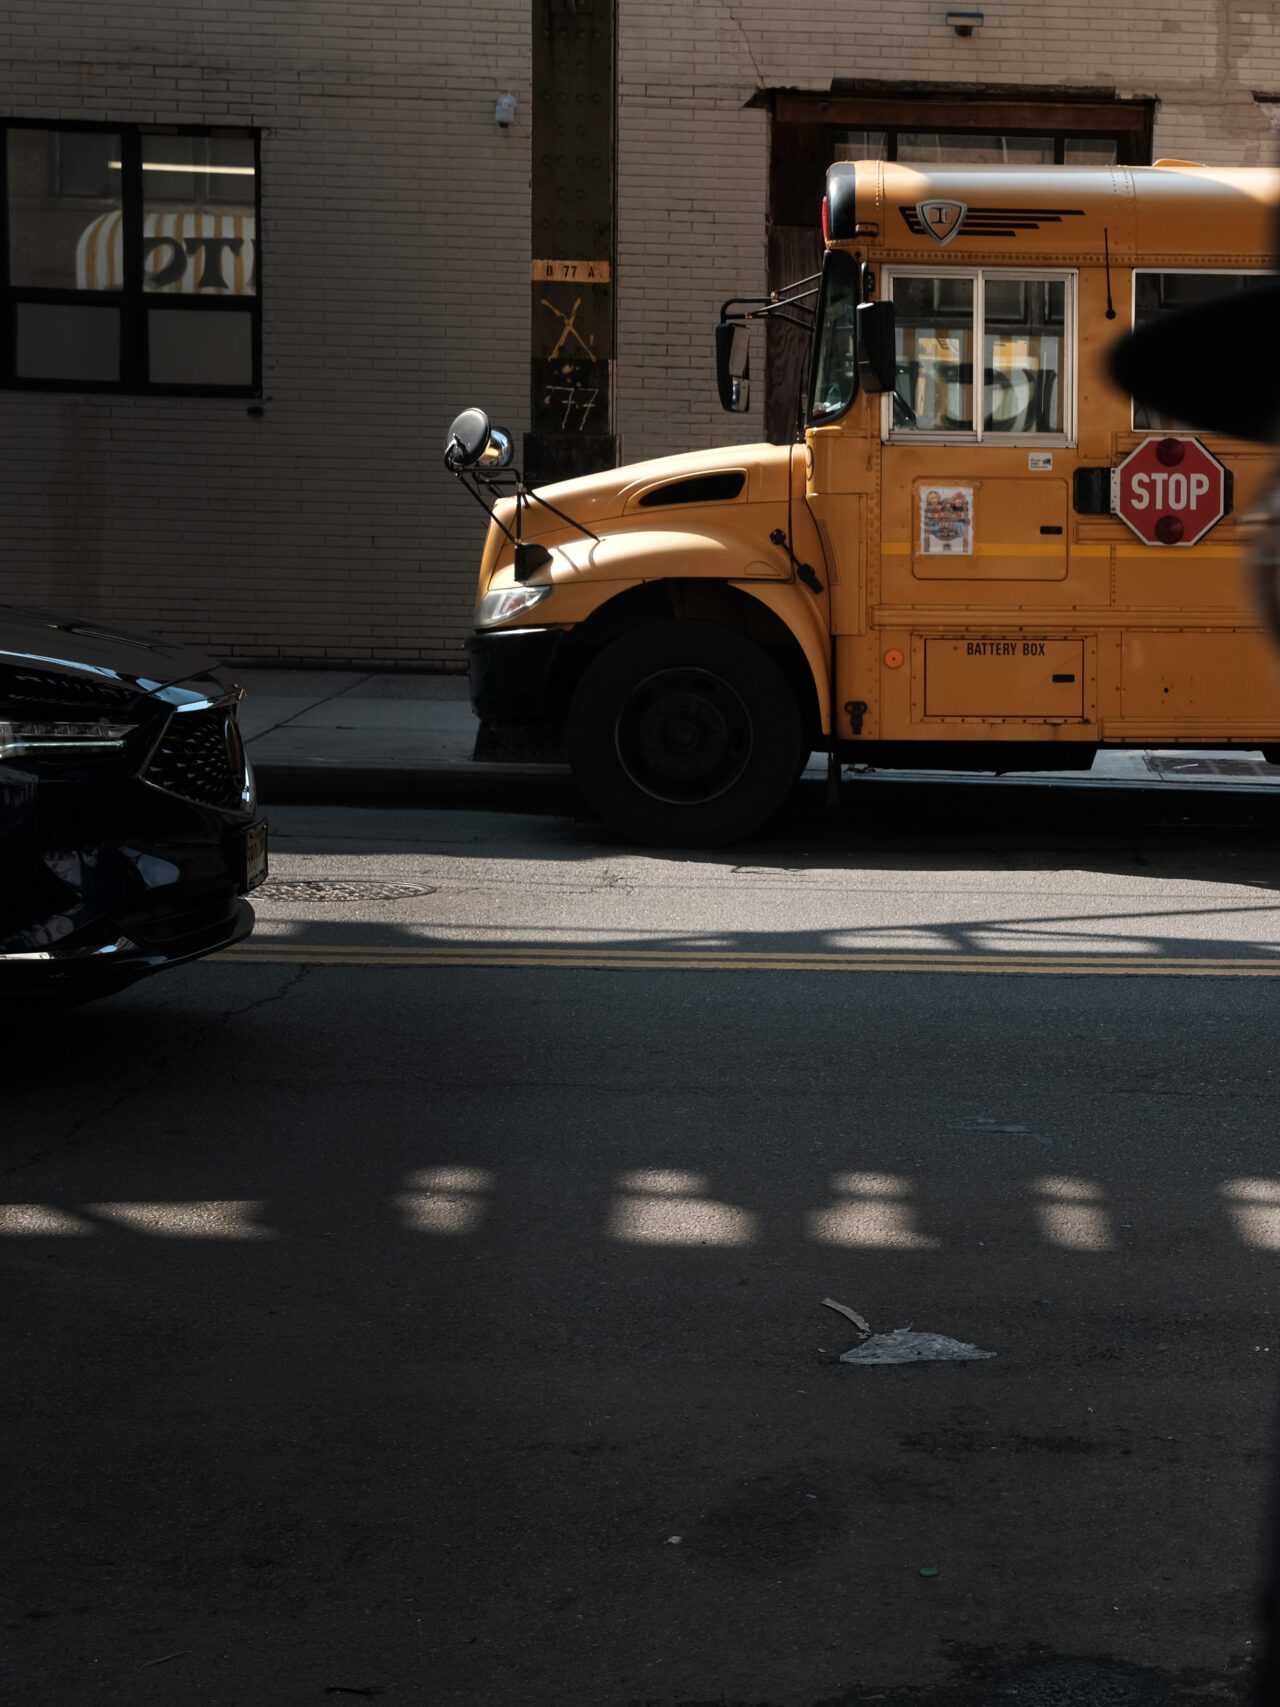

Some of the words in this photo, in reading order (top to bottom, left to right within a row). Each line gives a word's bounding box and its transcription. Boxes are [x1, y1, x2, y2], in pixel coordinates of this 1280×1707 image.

[564, 265, 577, 278] 77
[1131, 472, 1210, 511] STOP
[967, 642, 1017, 656] BATTERY
[1022, 642, 1045, 656] BOX
